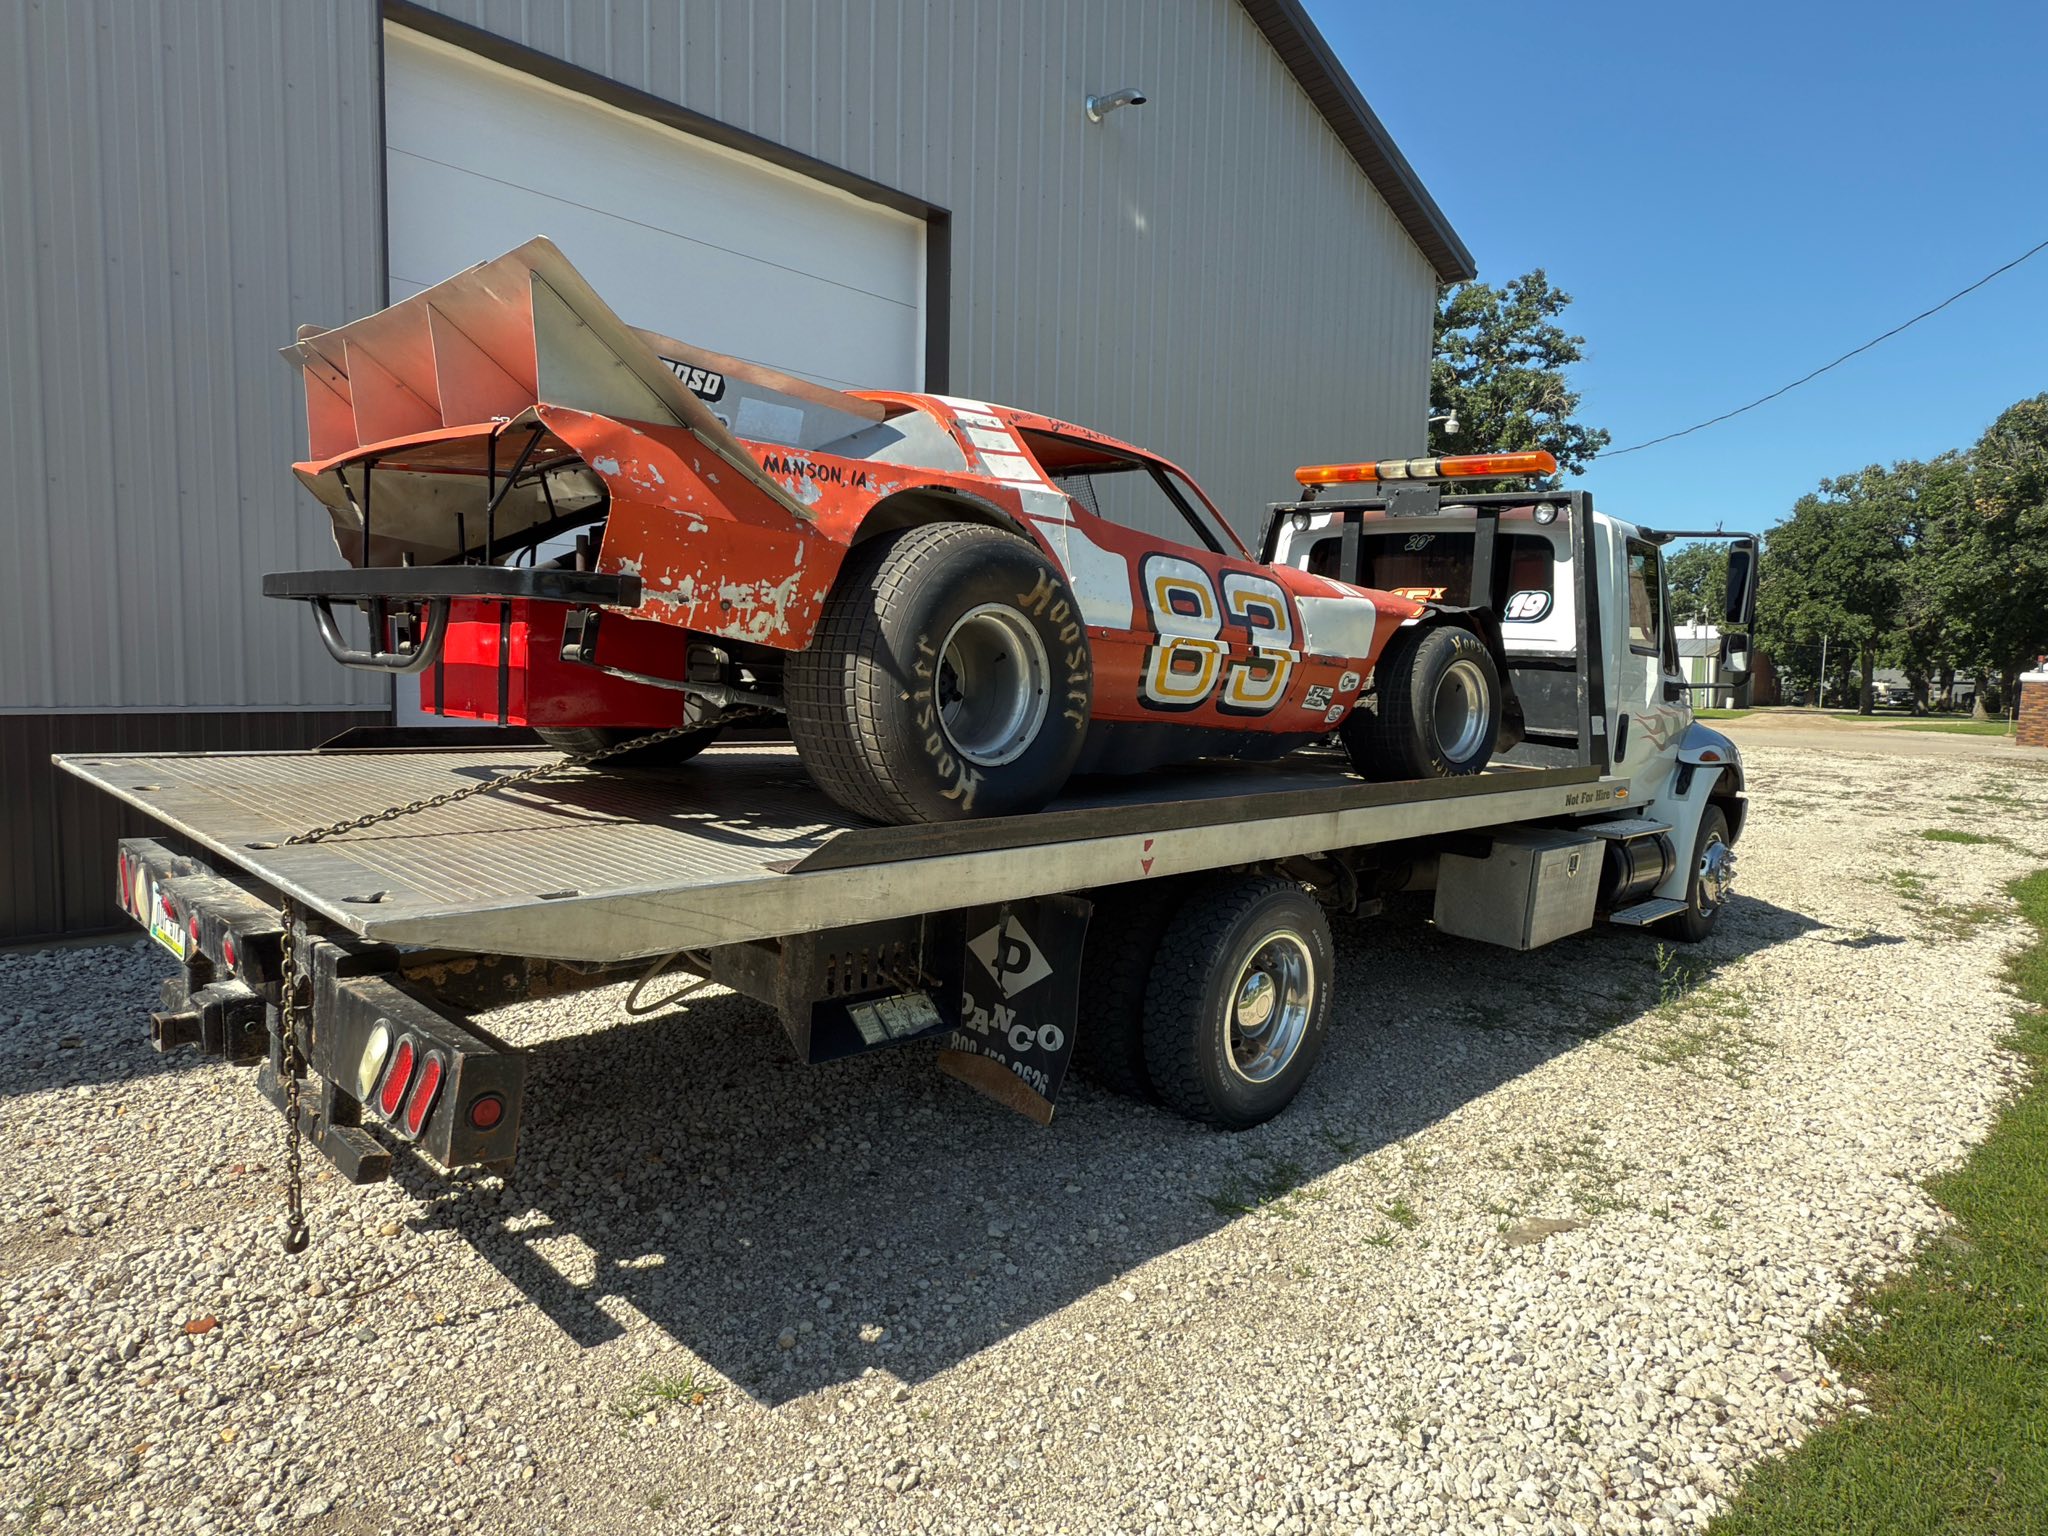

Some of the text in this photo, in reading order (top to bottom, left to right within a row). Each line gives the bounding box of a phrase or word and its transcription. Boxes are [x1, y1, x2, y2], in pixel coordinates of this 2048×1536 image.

[851, 470, 867, 488] IA
[1505, 591, 1550, 621] 19
[1138, 551, 1301, 717] 83
[1565, 789, 1611, 806] Not For Hire
